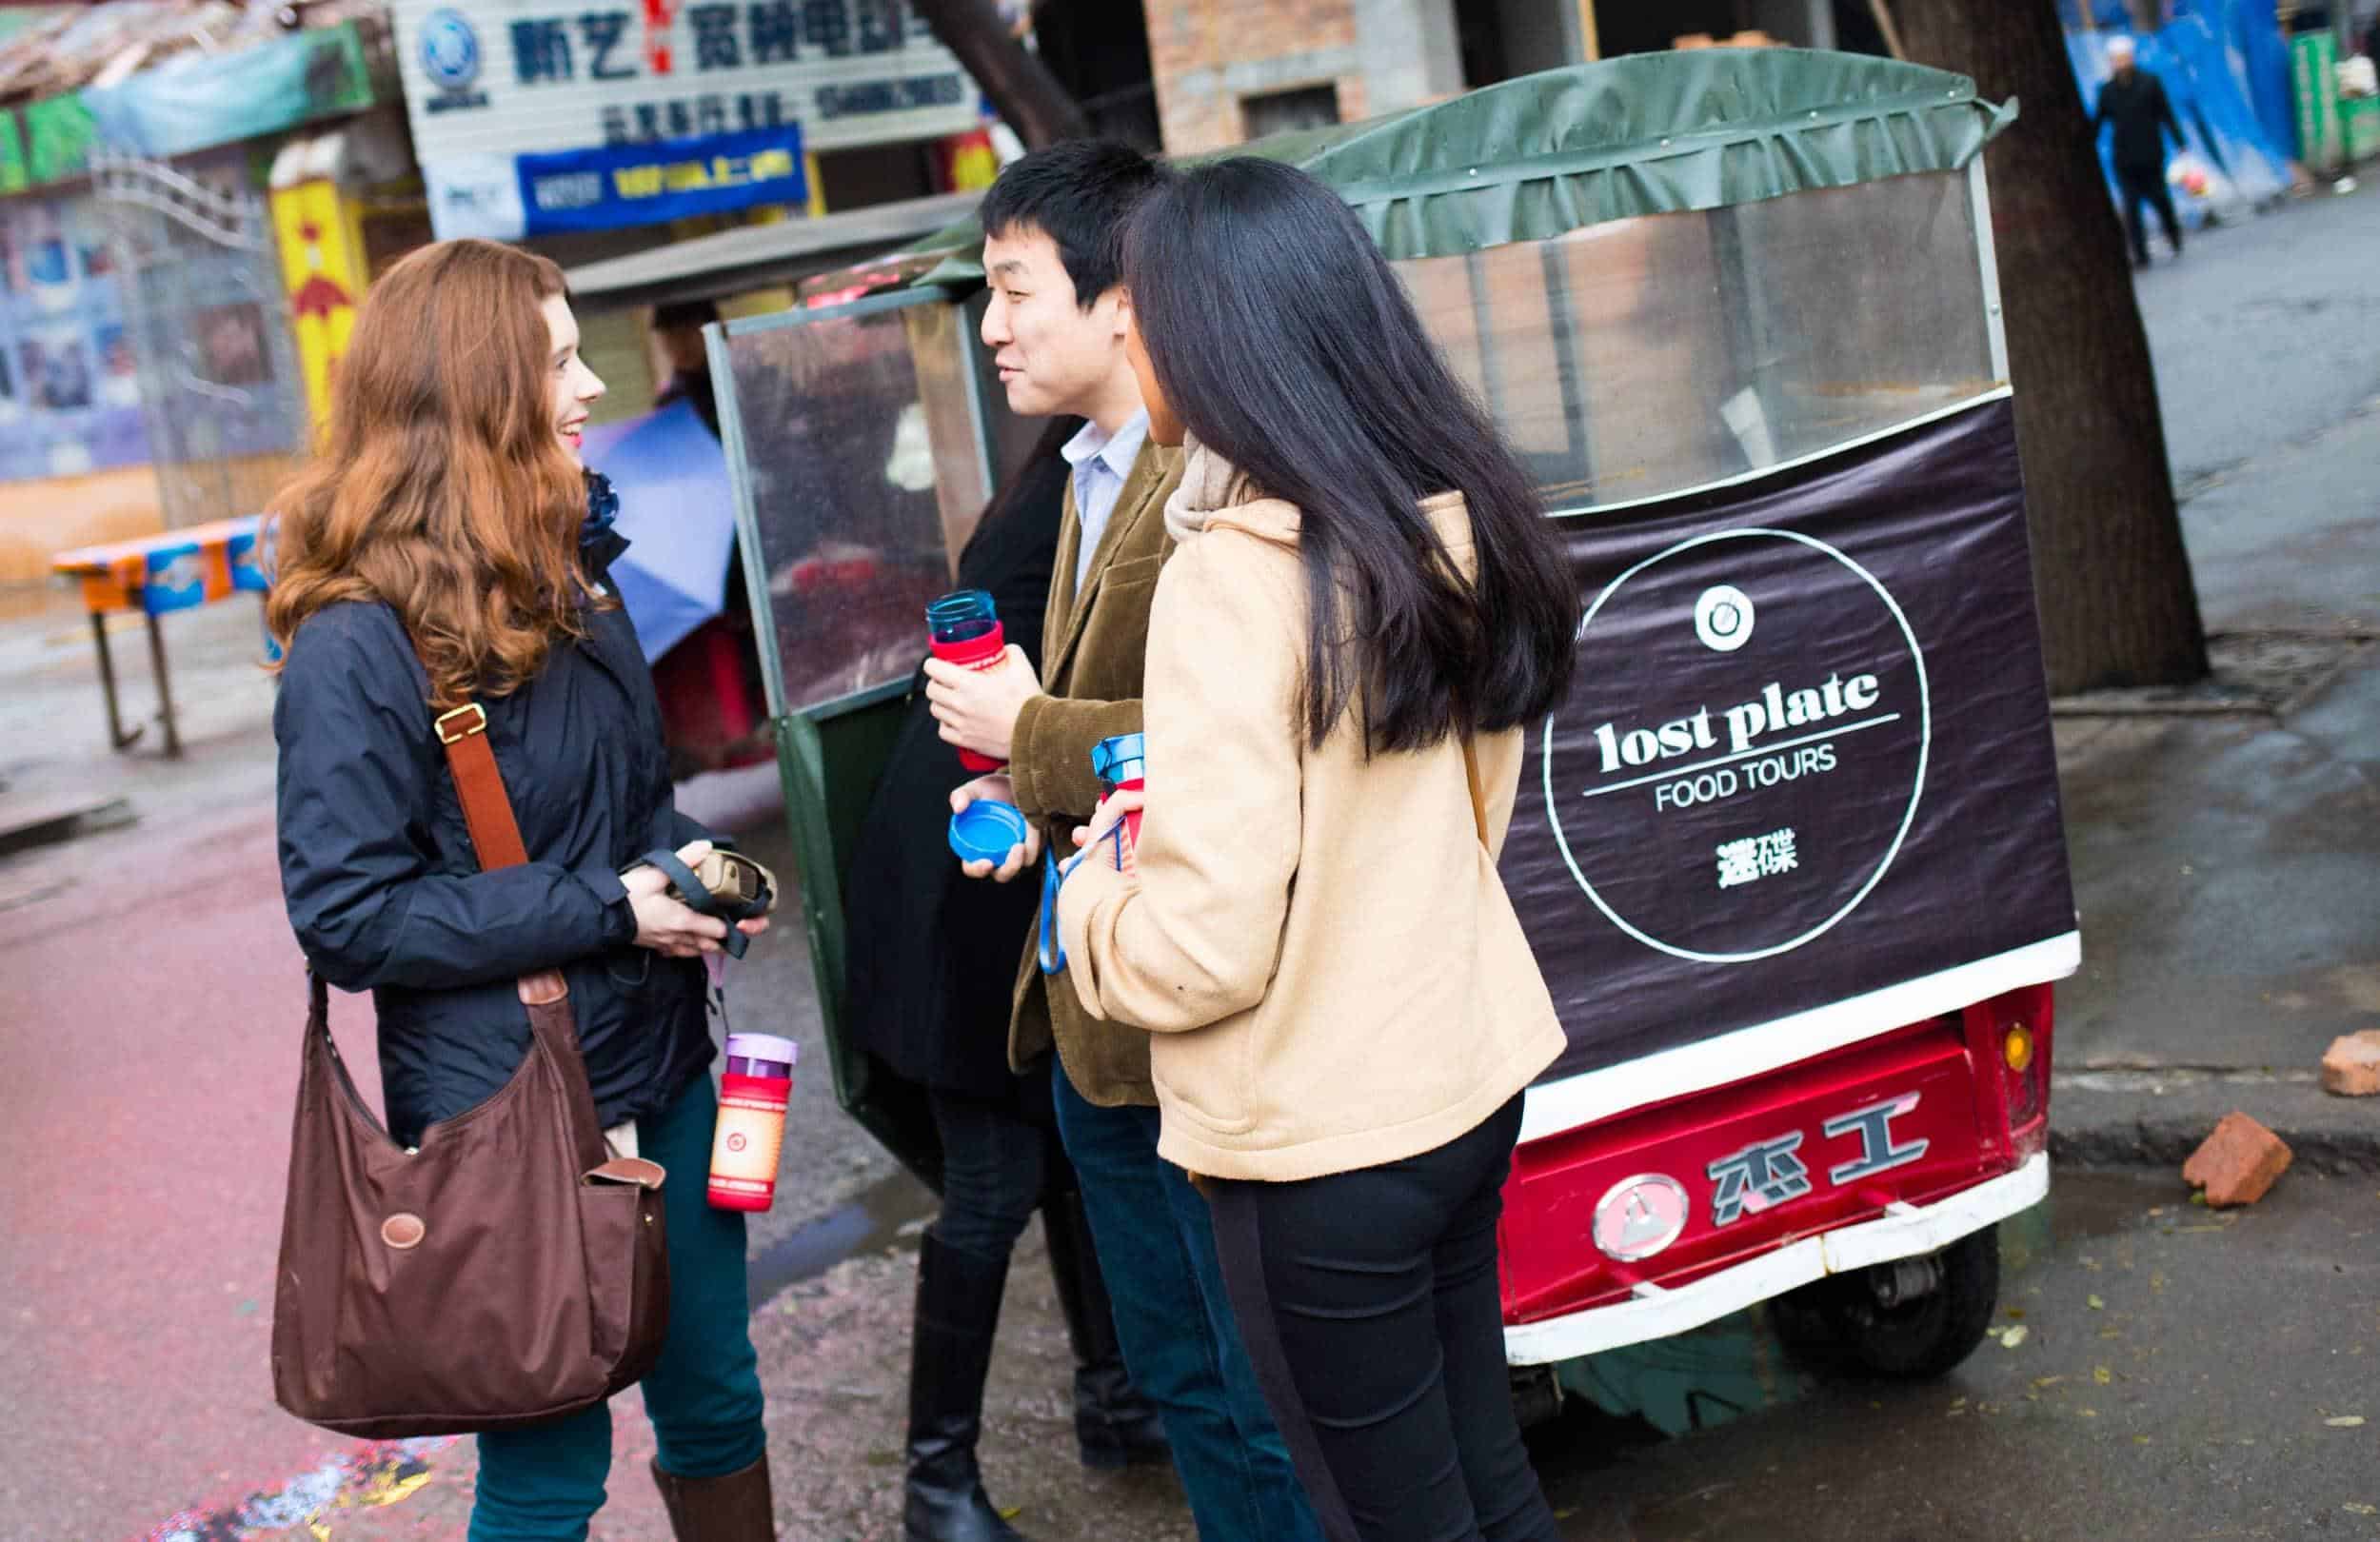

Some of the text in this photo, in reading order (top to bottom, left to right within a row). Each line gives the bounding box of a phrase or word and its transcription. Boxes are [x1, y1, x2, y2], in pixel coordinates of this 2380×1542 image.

[1594, 672, 1880, 774] lost plate
[1655, 743, 1837, 812] FOOD TOURS
